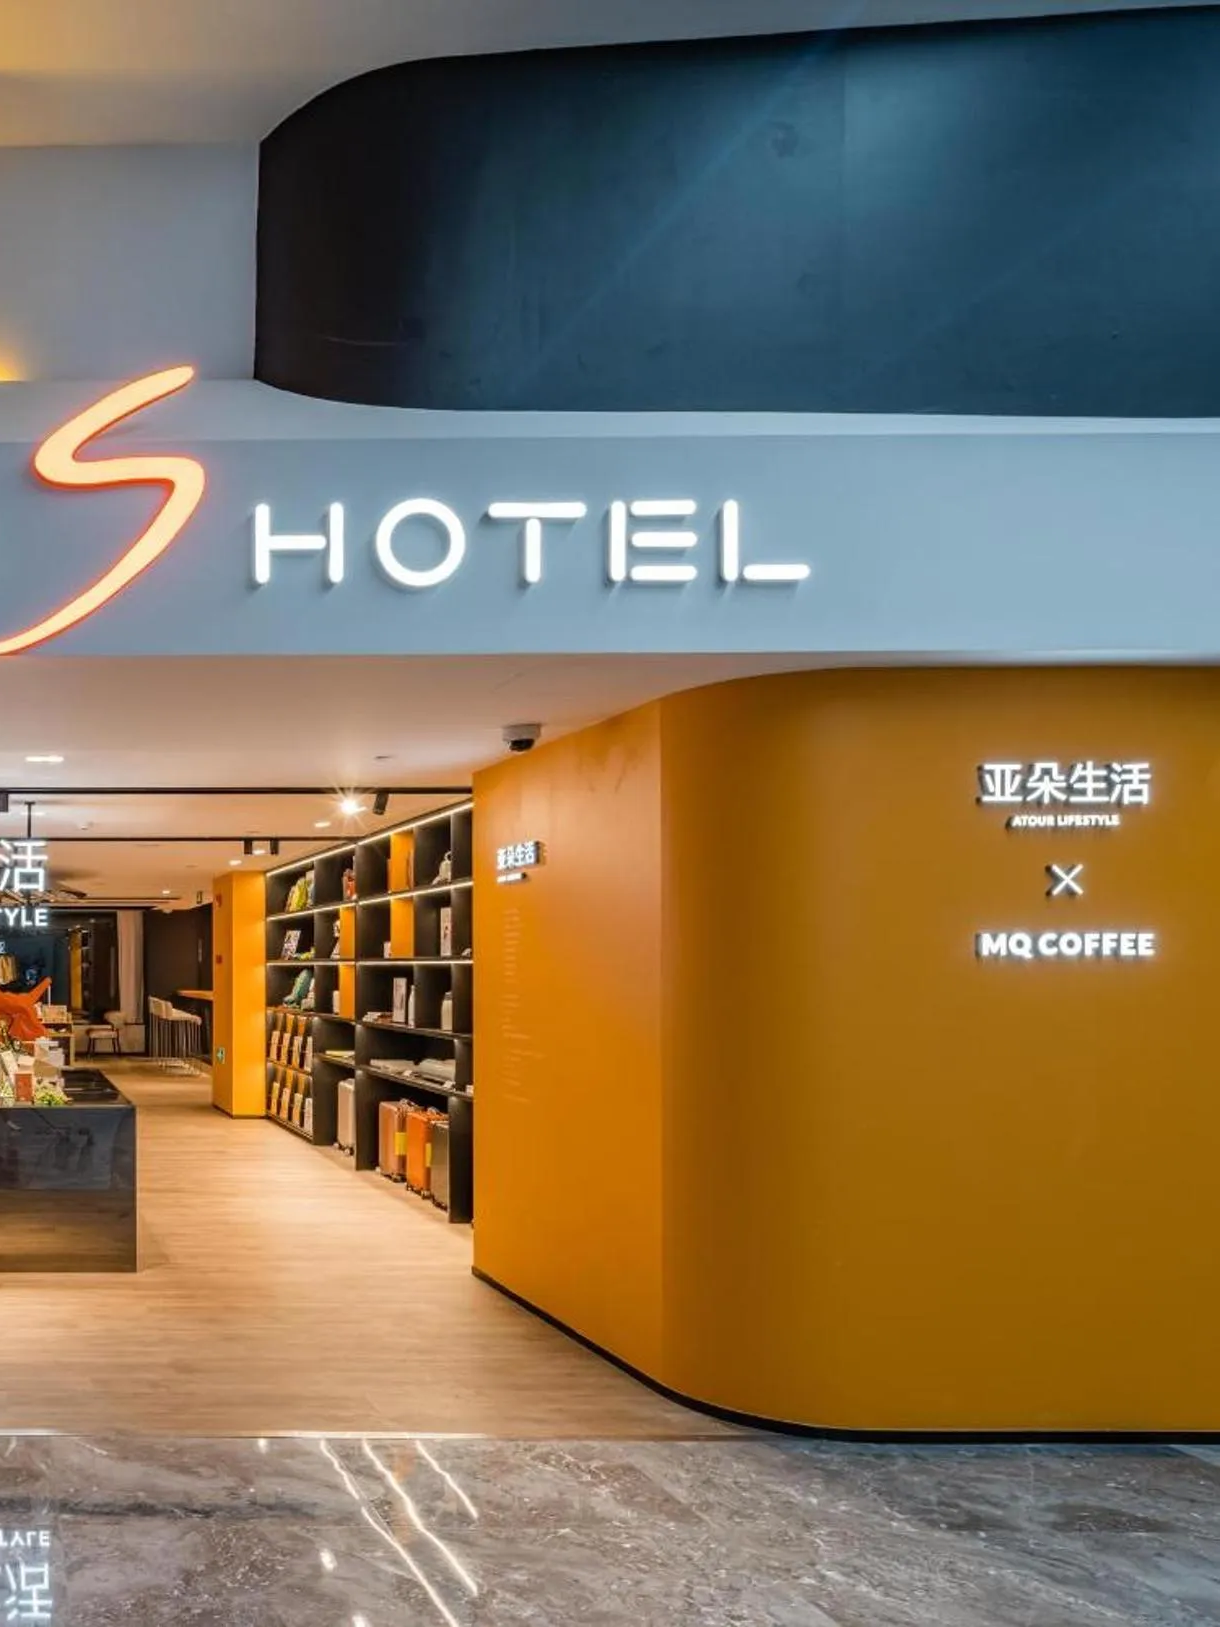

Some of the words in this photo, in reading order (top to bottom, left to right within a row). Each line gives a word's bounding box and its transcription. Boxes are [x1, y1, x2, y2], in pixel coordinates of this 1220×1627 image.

[254, 497, 812, 588] HOTEL
[981, 761, 1152, 805] 亚朵生活
[1011, 814, 1055, 827] ATOUR
[1057, 814, 1120, 827] LIFESTYLE
[981, 932, 1034, 959] MQ
[1037, 932, 1155, 957] COFFEE
